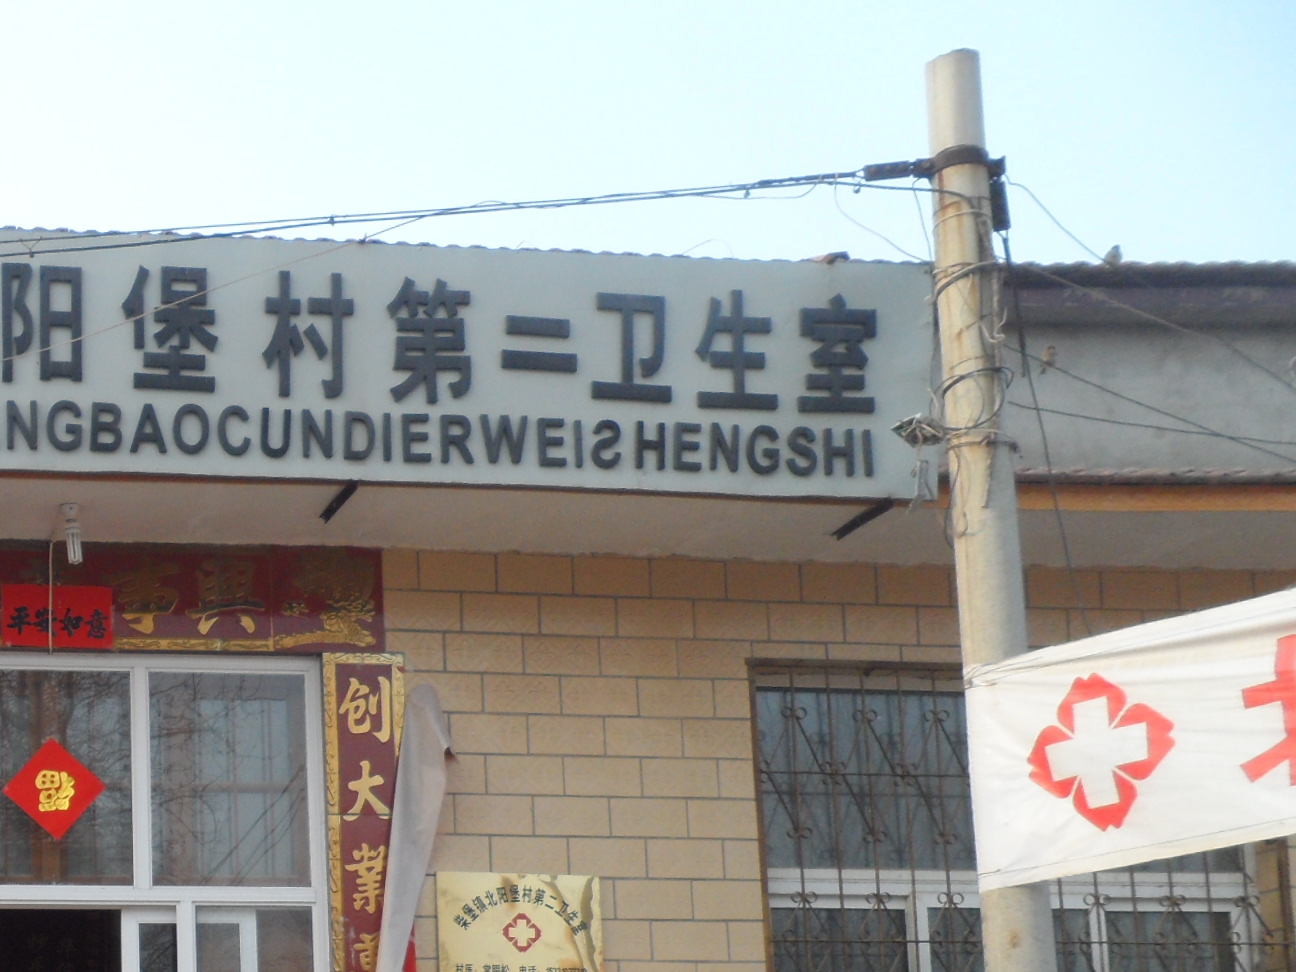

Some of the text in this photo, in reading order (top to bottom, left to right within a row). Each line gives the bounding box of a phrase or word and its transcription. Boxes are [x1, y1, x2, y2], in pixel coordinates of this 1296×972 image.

[7, 606, 108, 639] 平安如意
[452, 884, 588, 936] 柴堡镇北阳堡村第二卫生室
